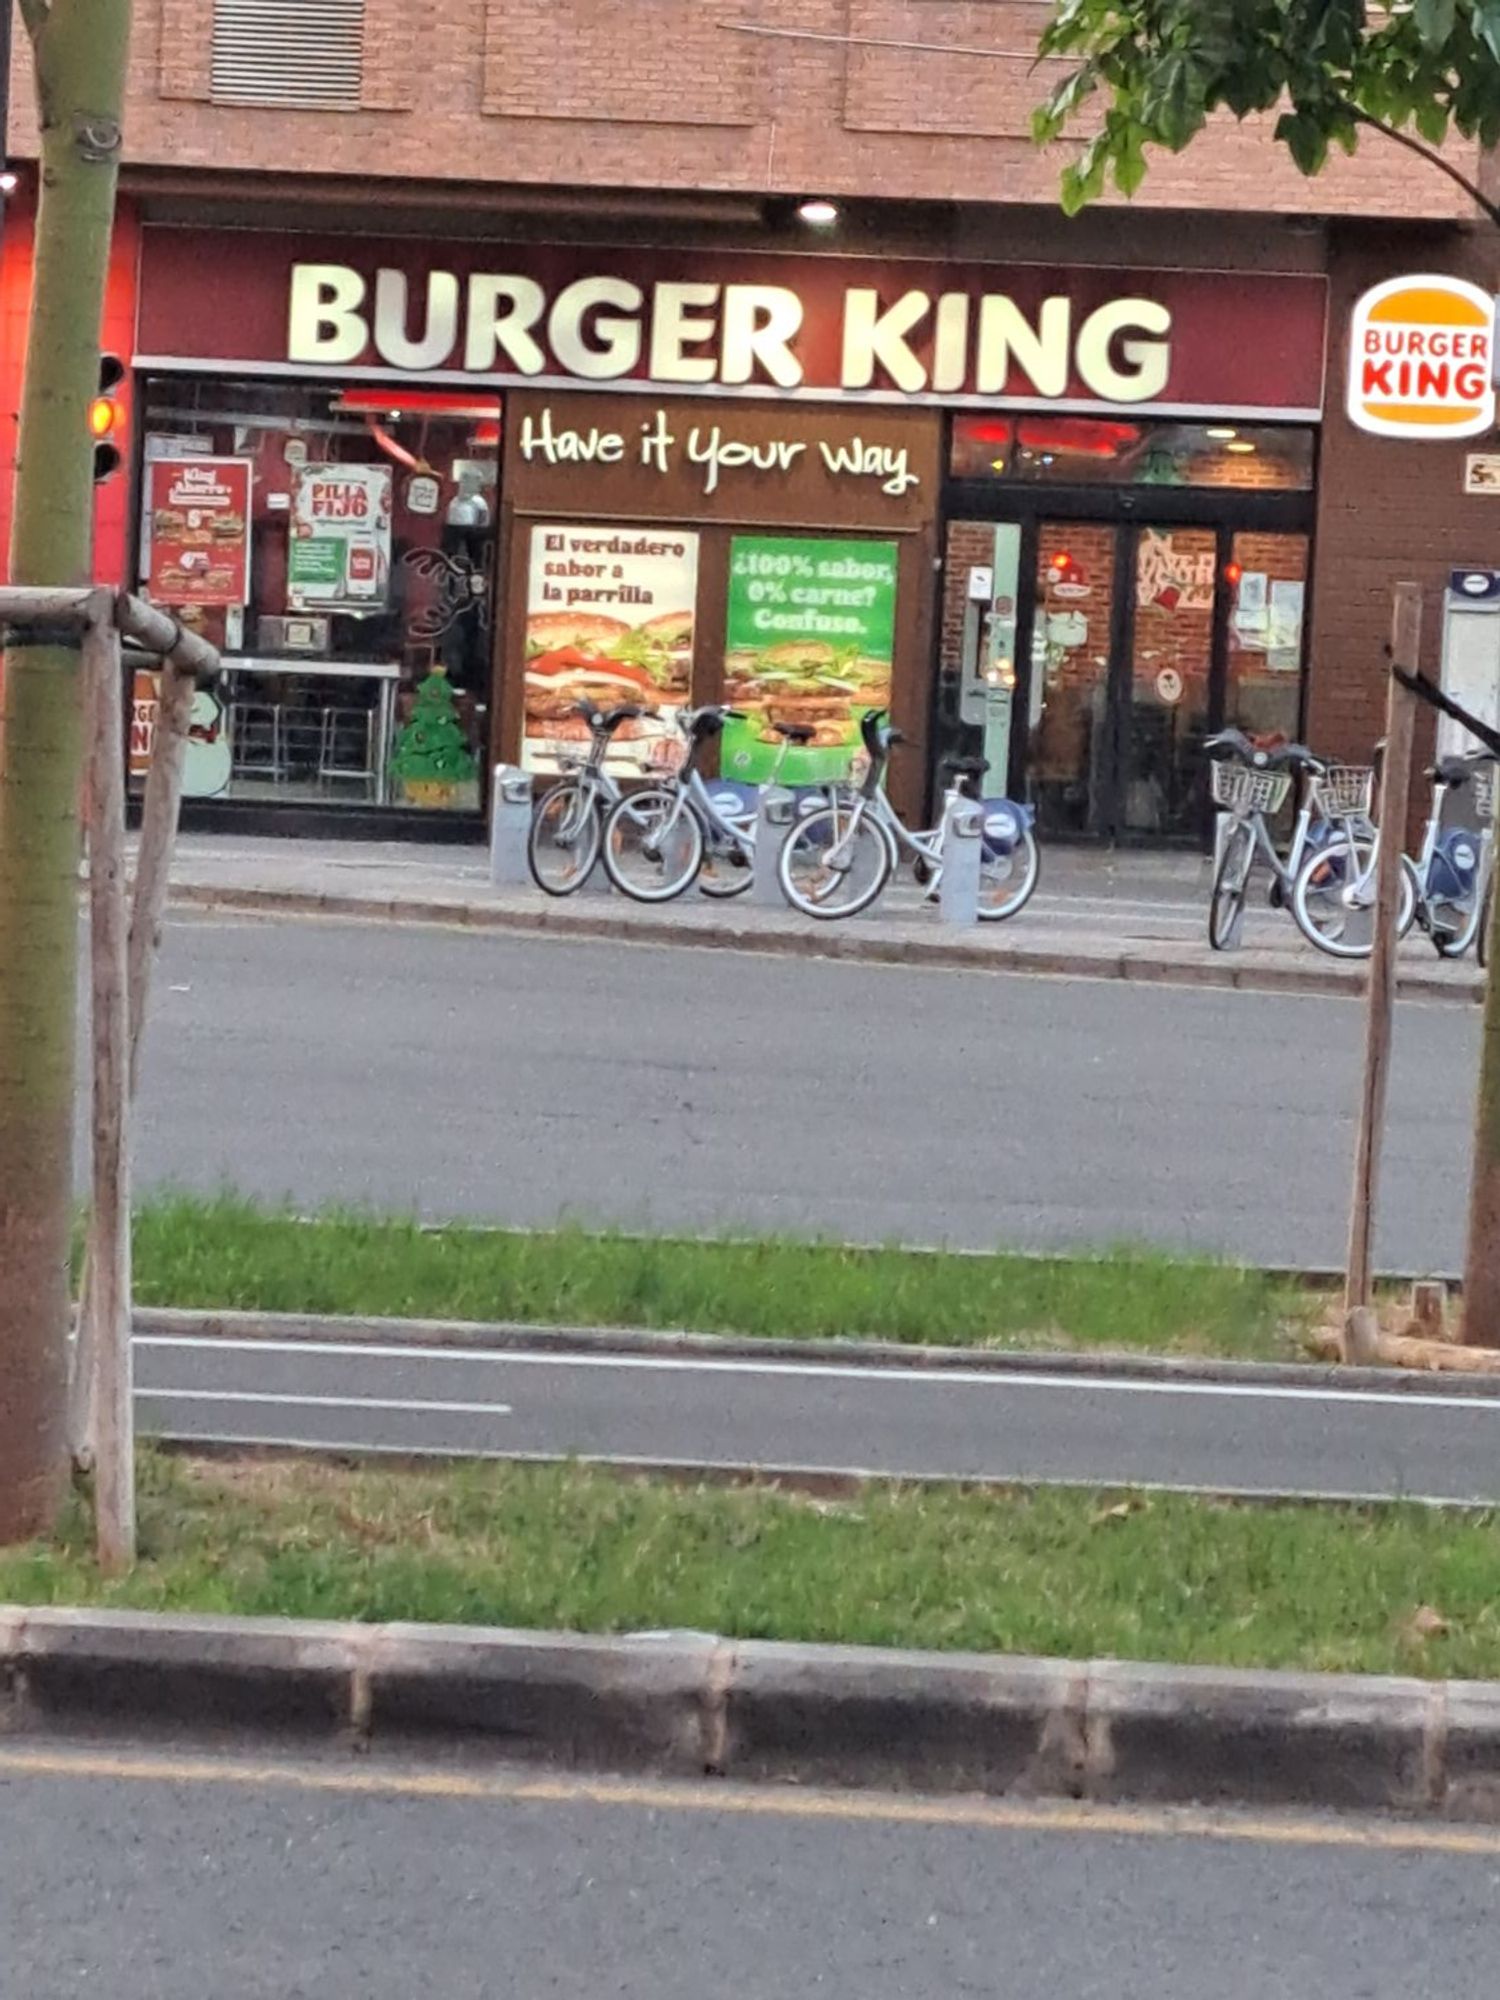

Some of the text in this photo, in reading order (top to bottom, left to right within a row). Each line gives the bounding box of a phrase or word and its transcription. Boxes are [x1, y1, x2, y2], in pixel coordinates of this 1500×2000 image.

[287, 263, 1172, 403] BURGER KING
[1364, 329, 1487, 359] BURGER
[1362, 359, 1486, 401] KING
[520, 409, 624, 463] Have
[641, 410, 674, 473] it
[311, 483, 368, 500] PILLA
[545, 534, 685, 557] El verdadero
[544, 559, 623, 579] sabor a
[543, 582, 653, 606] la parrilla
[747, 579, 876, 607] 0% carne?
[754, 608, 868, 634] Confuso.
